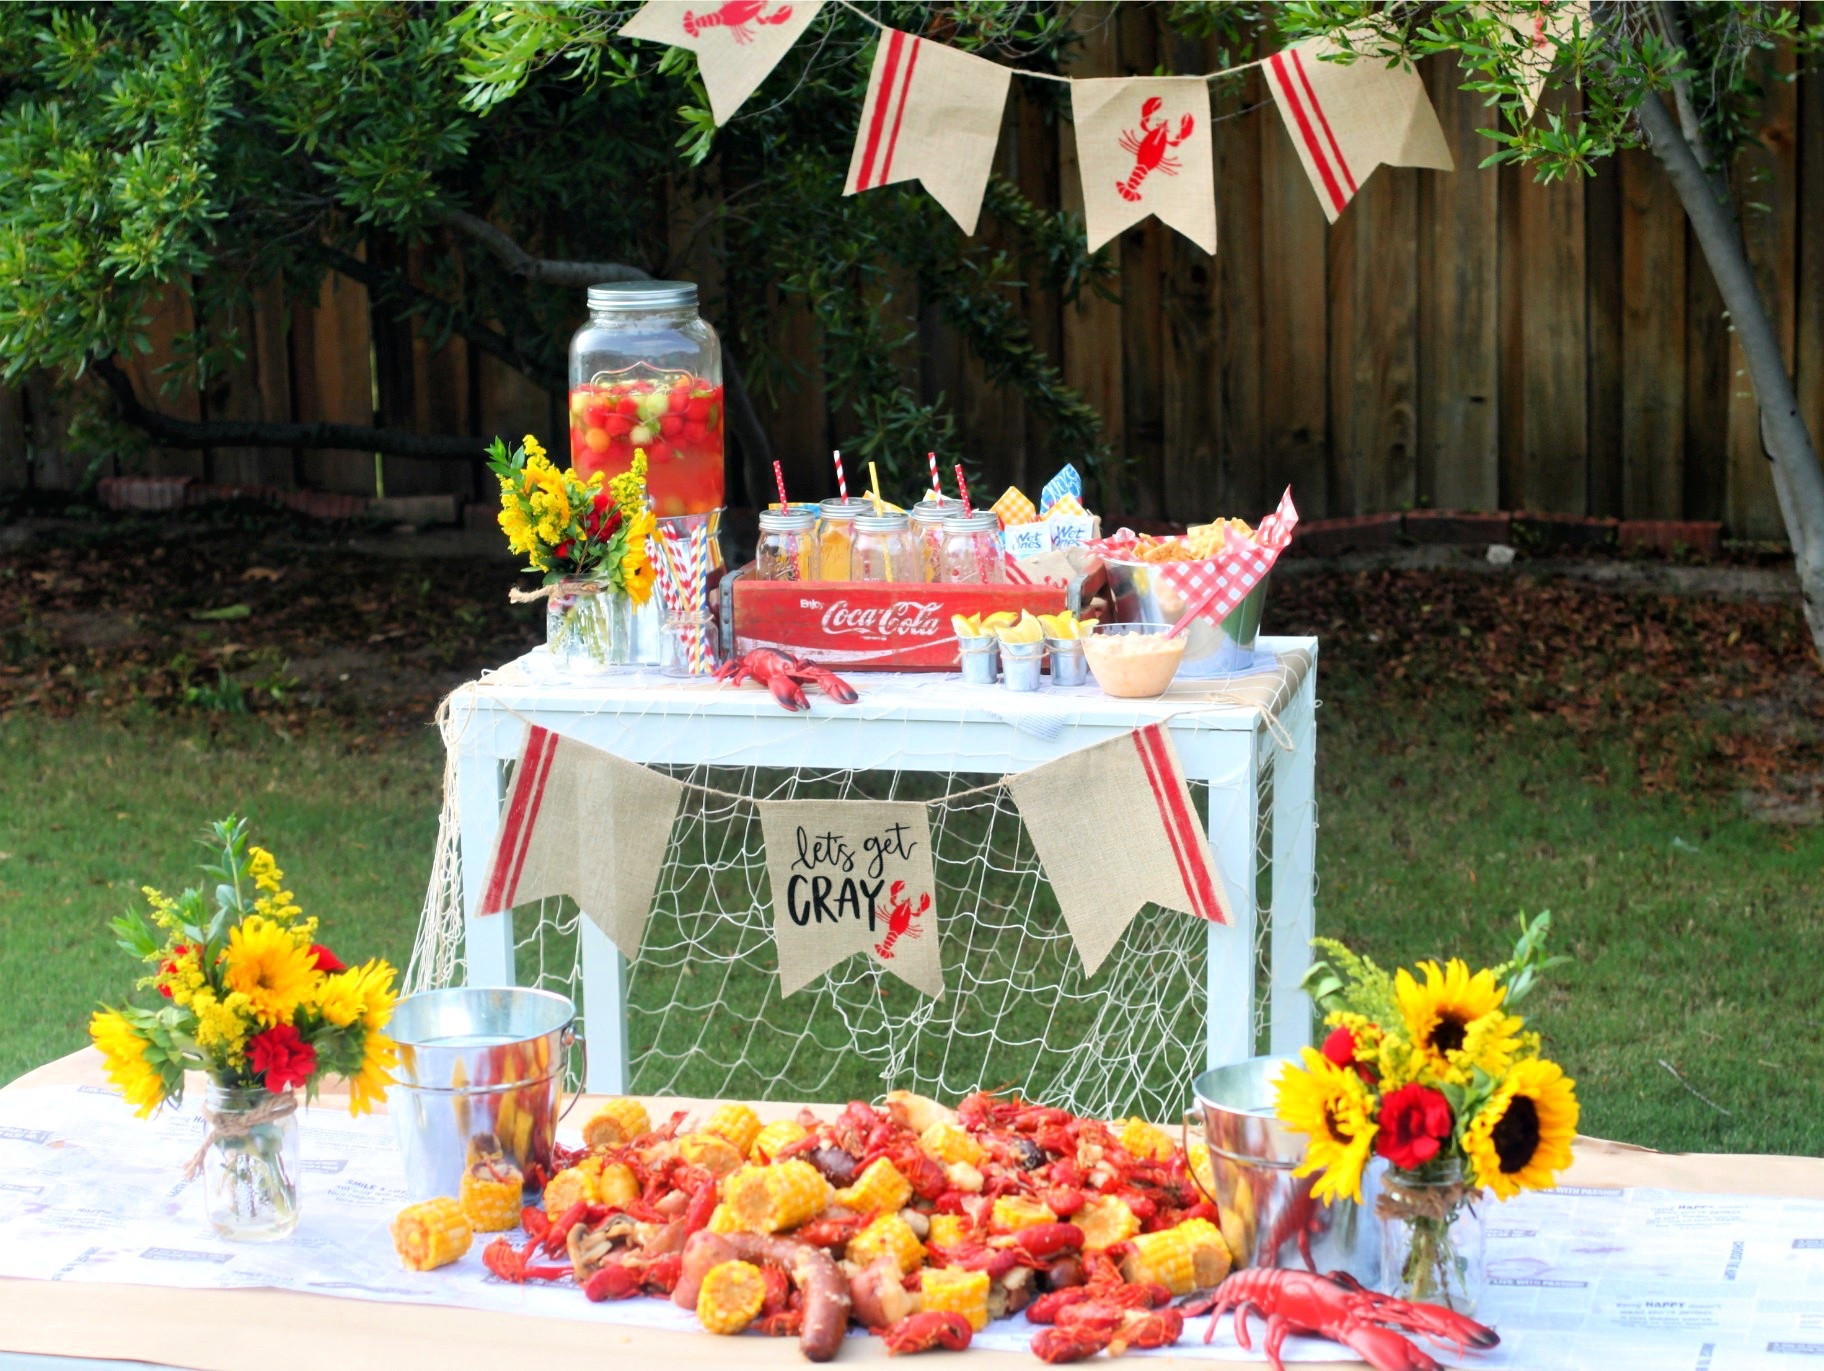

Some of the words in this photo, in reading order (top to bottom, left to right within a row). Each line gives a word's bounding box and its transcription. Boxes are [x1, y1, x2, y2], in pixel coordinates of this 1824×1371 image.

[1015, 532, 1042, 542] Wet
[1057, 526, 1085, 539] Wet
[821, 600, 944, 635] Coca-Cola
[863, 822, 917, 878] get
[787, 874, 885, 932] CRAY
[1556, 1186, 1580, 1195] WITH
